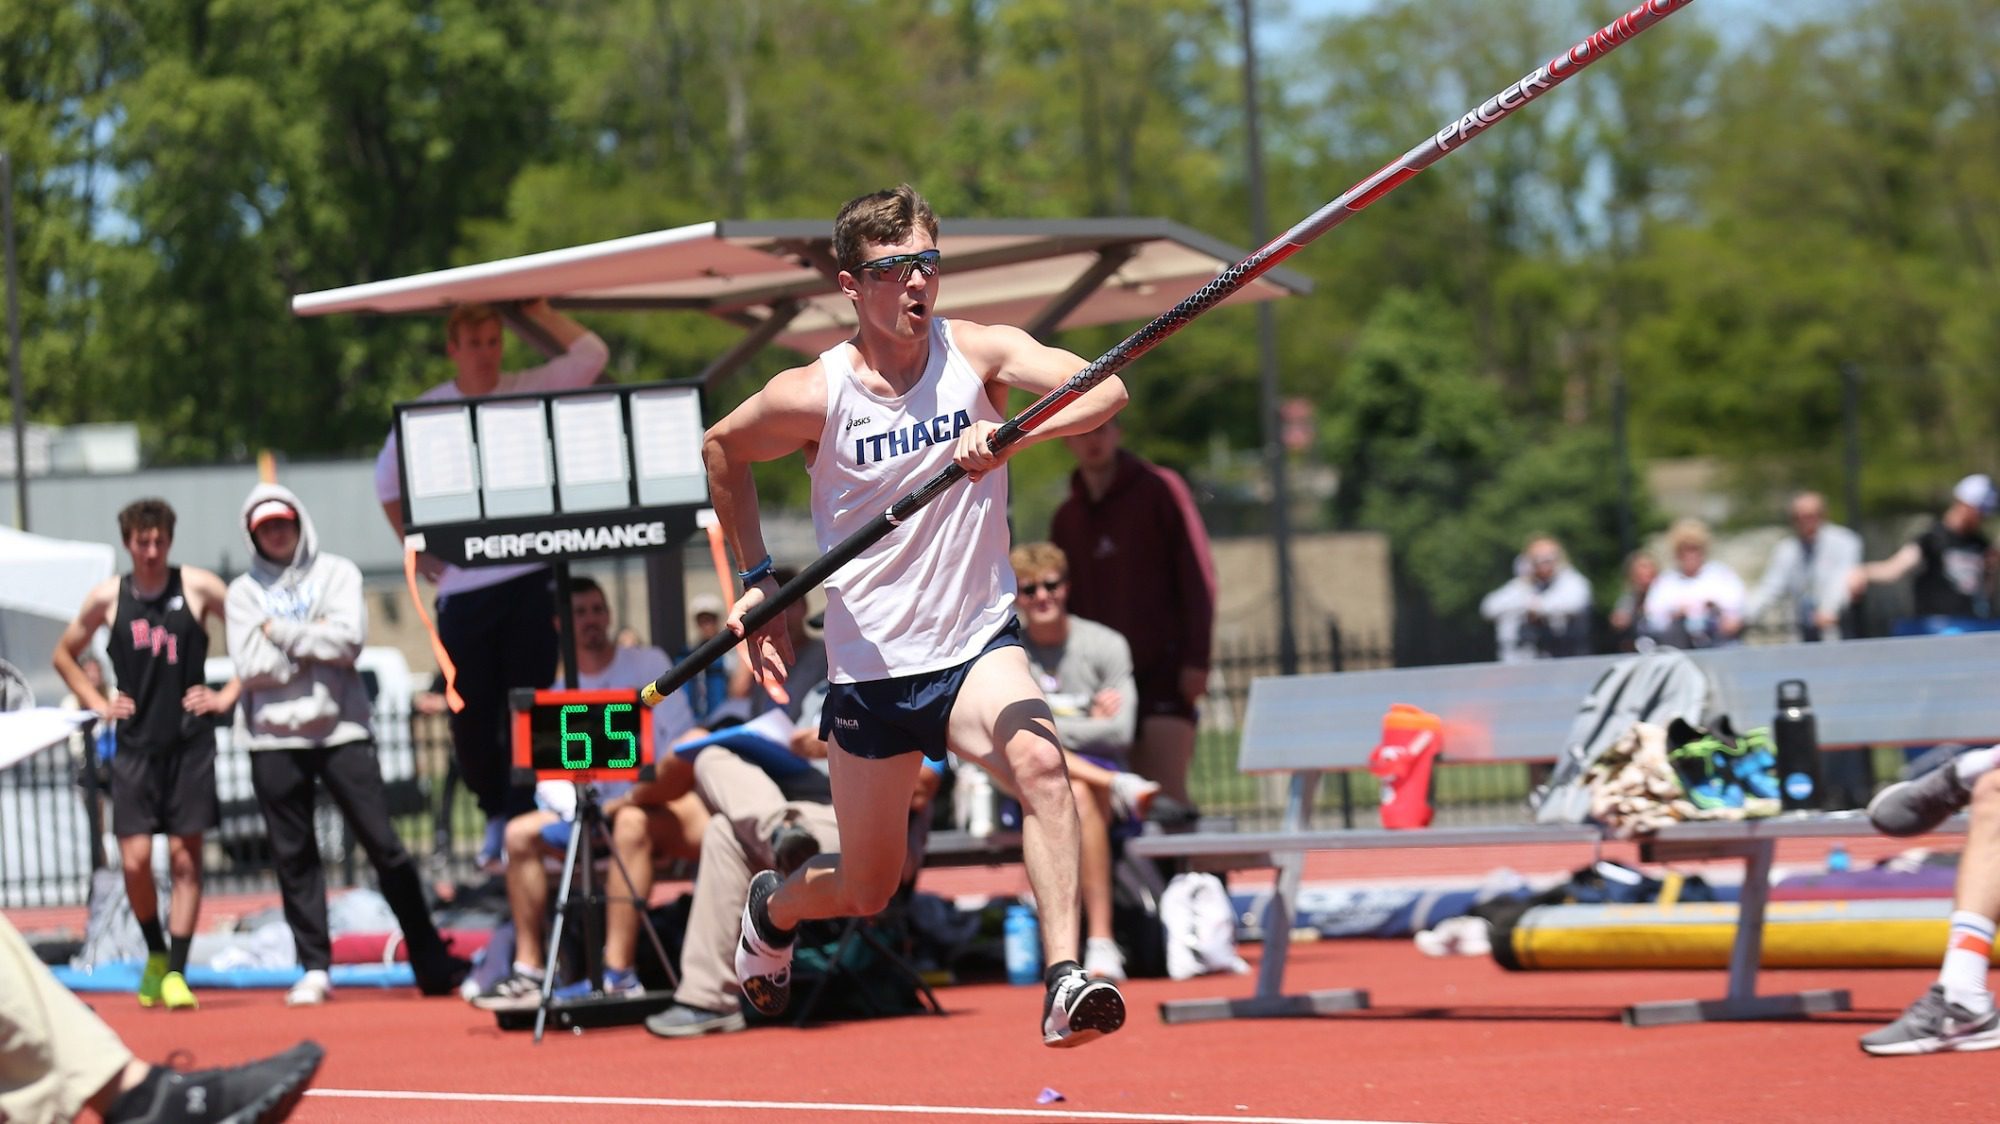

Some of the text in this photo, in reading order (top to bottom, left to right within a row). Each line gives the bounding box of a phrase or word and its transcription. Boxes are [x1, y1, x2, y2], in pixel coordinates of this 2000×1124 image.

[855, 408, 972, 466] ITHACA
[464, 521, 666, 562] PERFORMANCE
[130, 618, 178, 665] RPI
[561, 704, 636, 769] 65
